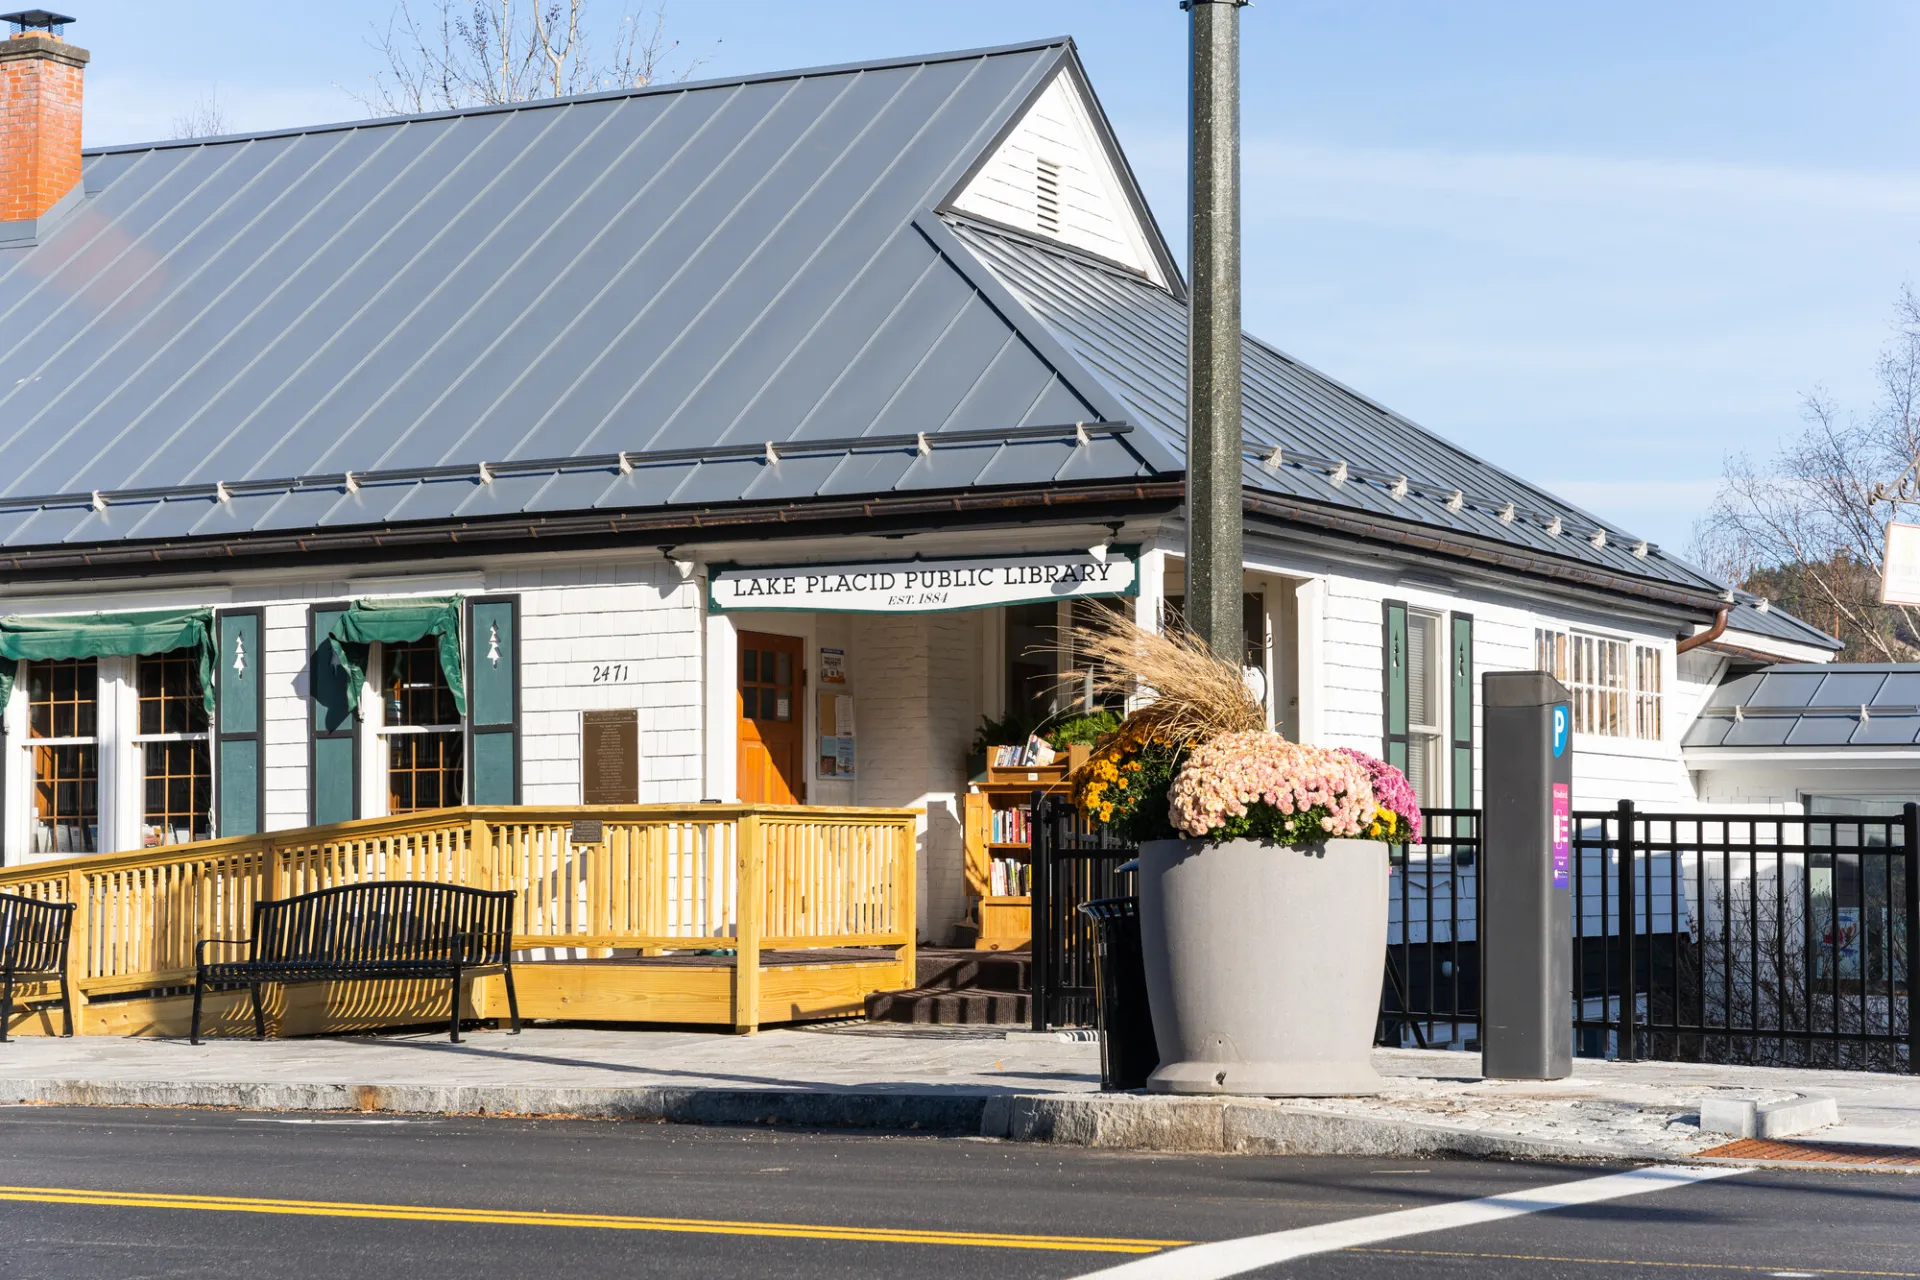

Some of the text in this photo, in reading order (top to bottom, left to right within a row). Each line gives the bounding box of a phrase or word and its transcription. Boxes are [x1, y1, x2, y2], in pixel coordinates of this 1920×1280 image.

[733, 563, 1112, 596] LAKE PLACID PUBLIC LIBRARY
[888, 592, 948, 606] EST. 1884
[592, 664, 629, 682] 2471
[1555, 710, 1565, 747] P
